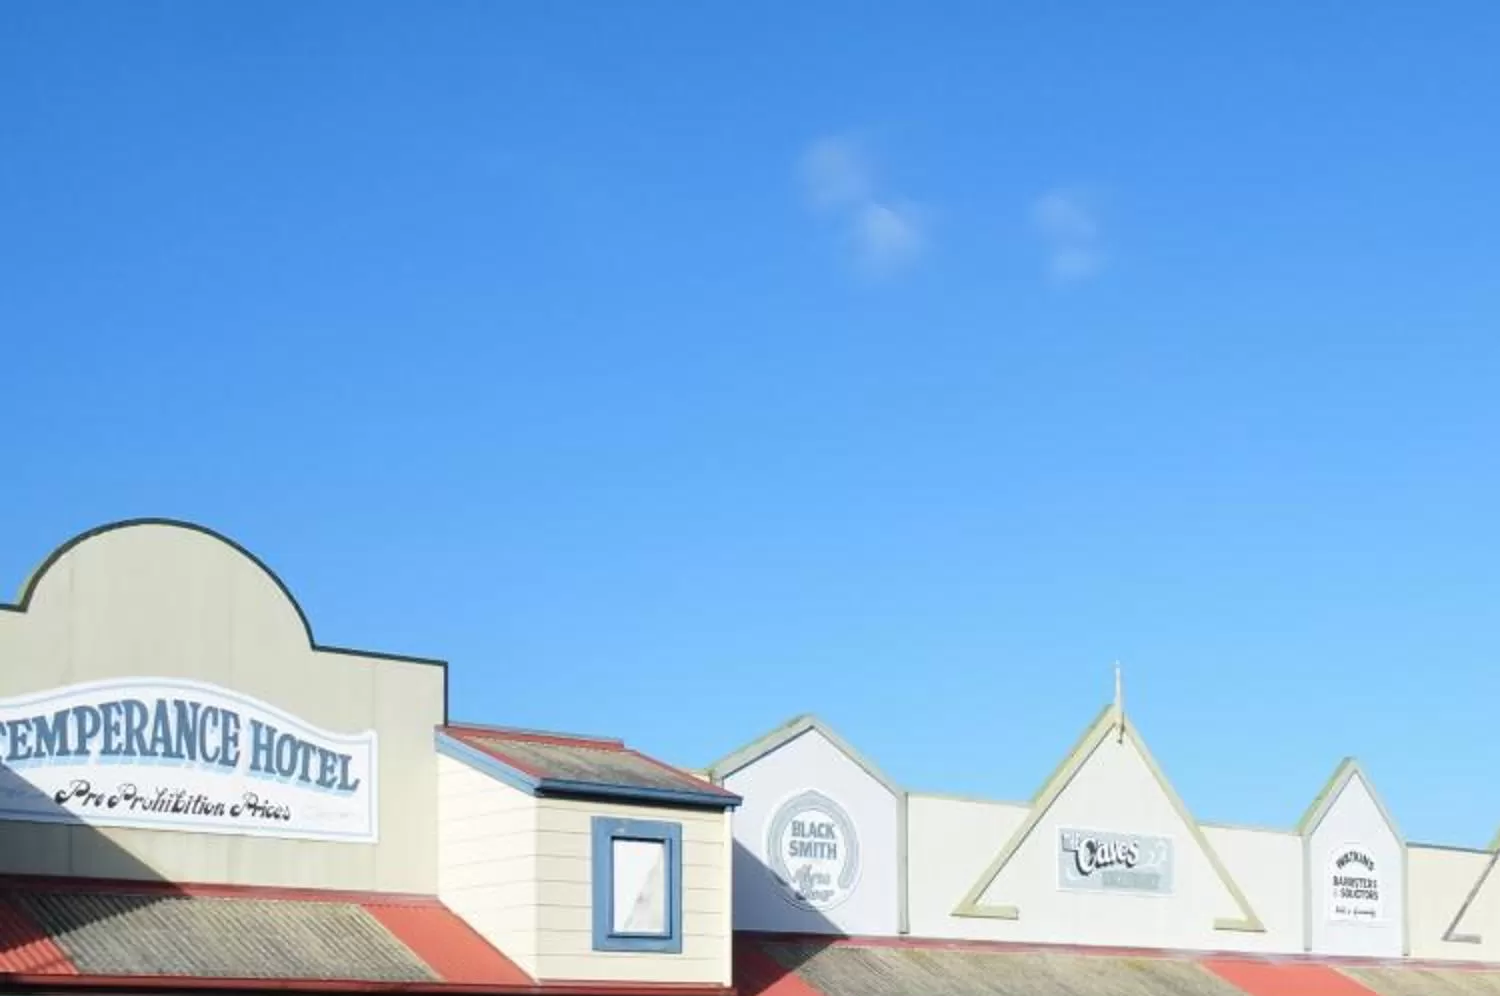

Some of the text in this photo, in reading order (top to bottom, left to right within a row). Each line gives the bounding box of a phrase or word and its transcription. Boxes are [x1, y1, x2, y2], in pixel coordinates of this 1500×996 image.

[0, 698, 359, 792] EMPERANCE HOTEL
[55, 779, 291, 820] Pre Prohibition Prices
[791, 820, 835, 839] BLACK
[789, 840, 837, 860] SMITH
